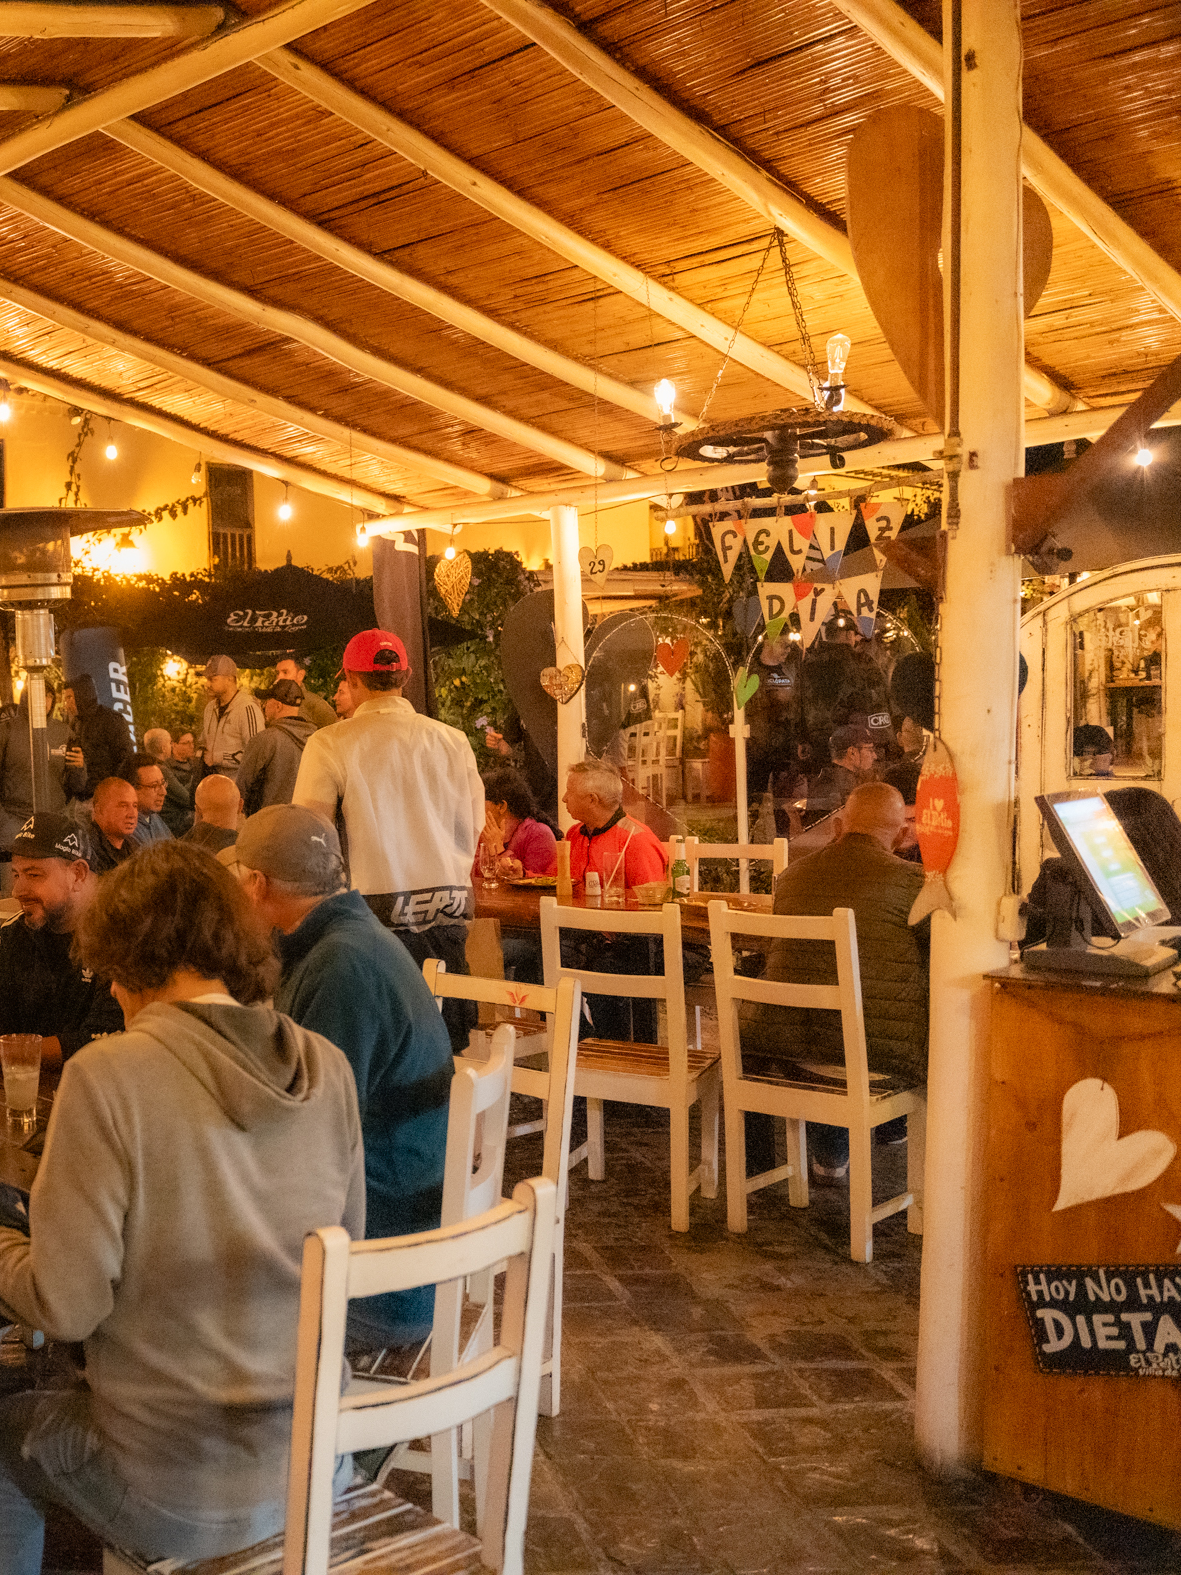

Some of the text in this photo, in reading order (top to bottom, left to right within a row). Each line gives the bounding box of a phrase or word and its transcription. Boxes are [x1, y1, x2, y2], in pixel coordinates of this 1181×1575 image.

[721, 515, 894, 564] FELIZ
[589, 559, 606, 575] 29
[226, 609, 309, 627] El Patio
[1136, 1272, 1181, 1304] HA
